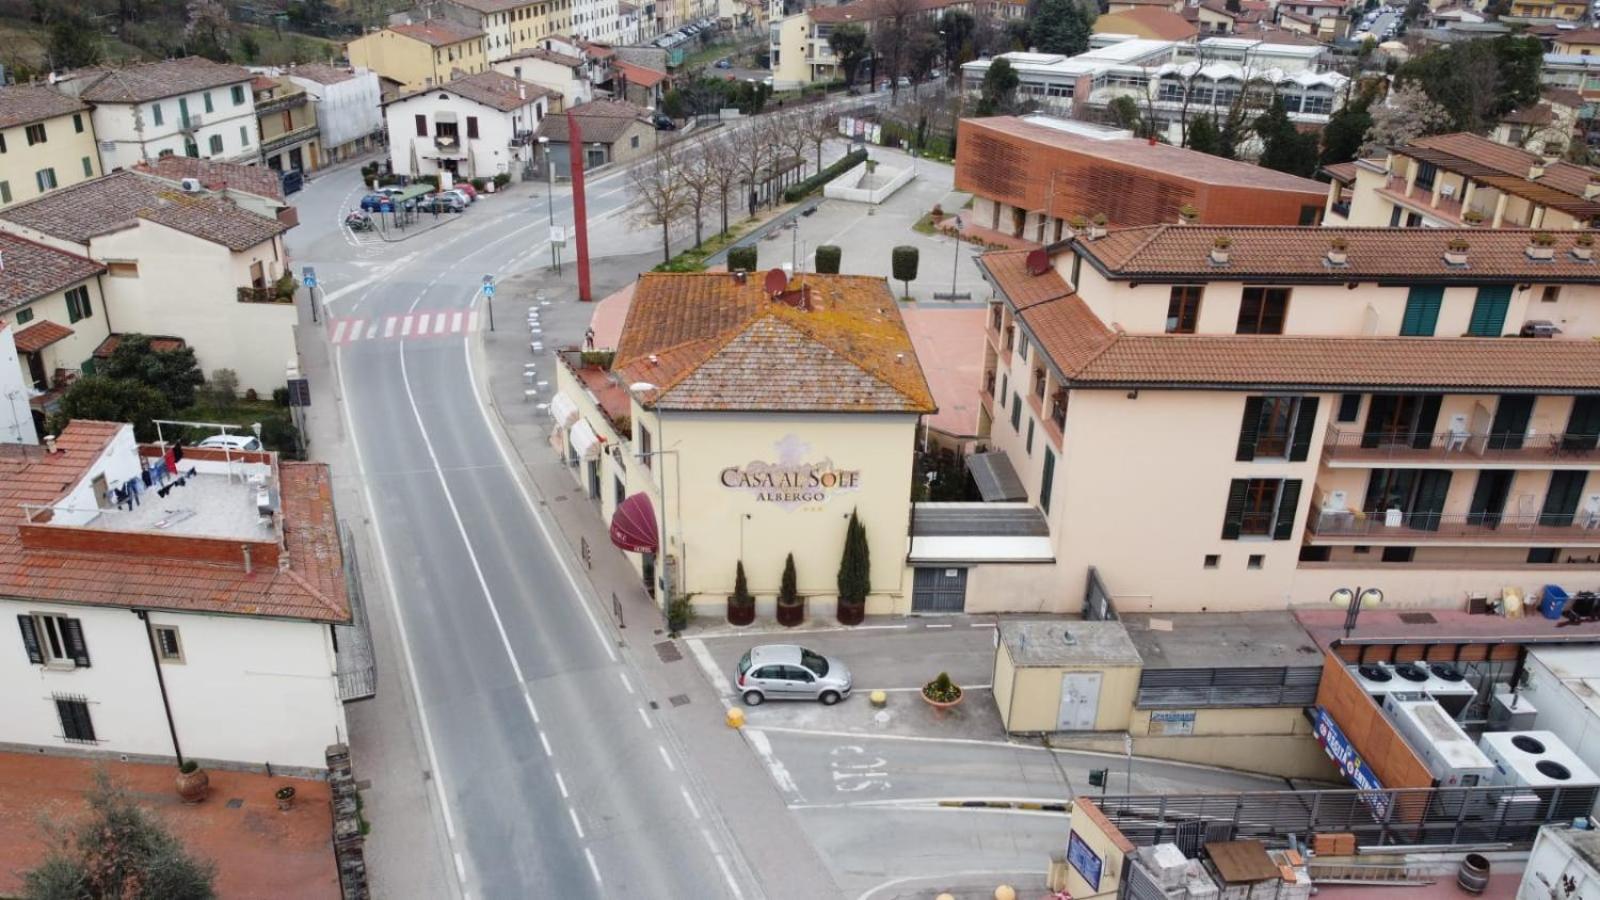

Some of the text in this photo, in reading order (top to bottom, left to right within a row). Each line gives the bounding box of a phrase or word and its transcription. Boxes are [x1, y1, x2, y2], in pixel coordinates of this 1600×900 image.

[721, 467, 860, 488] CASA AL SOLE
[756, 492, 826, 502] ALBERGO
